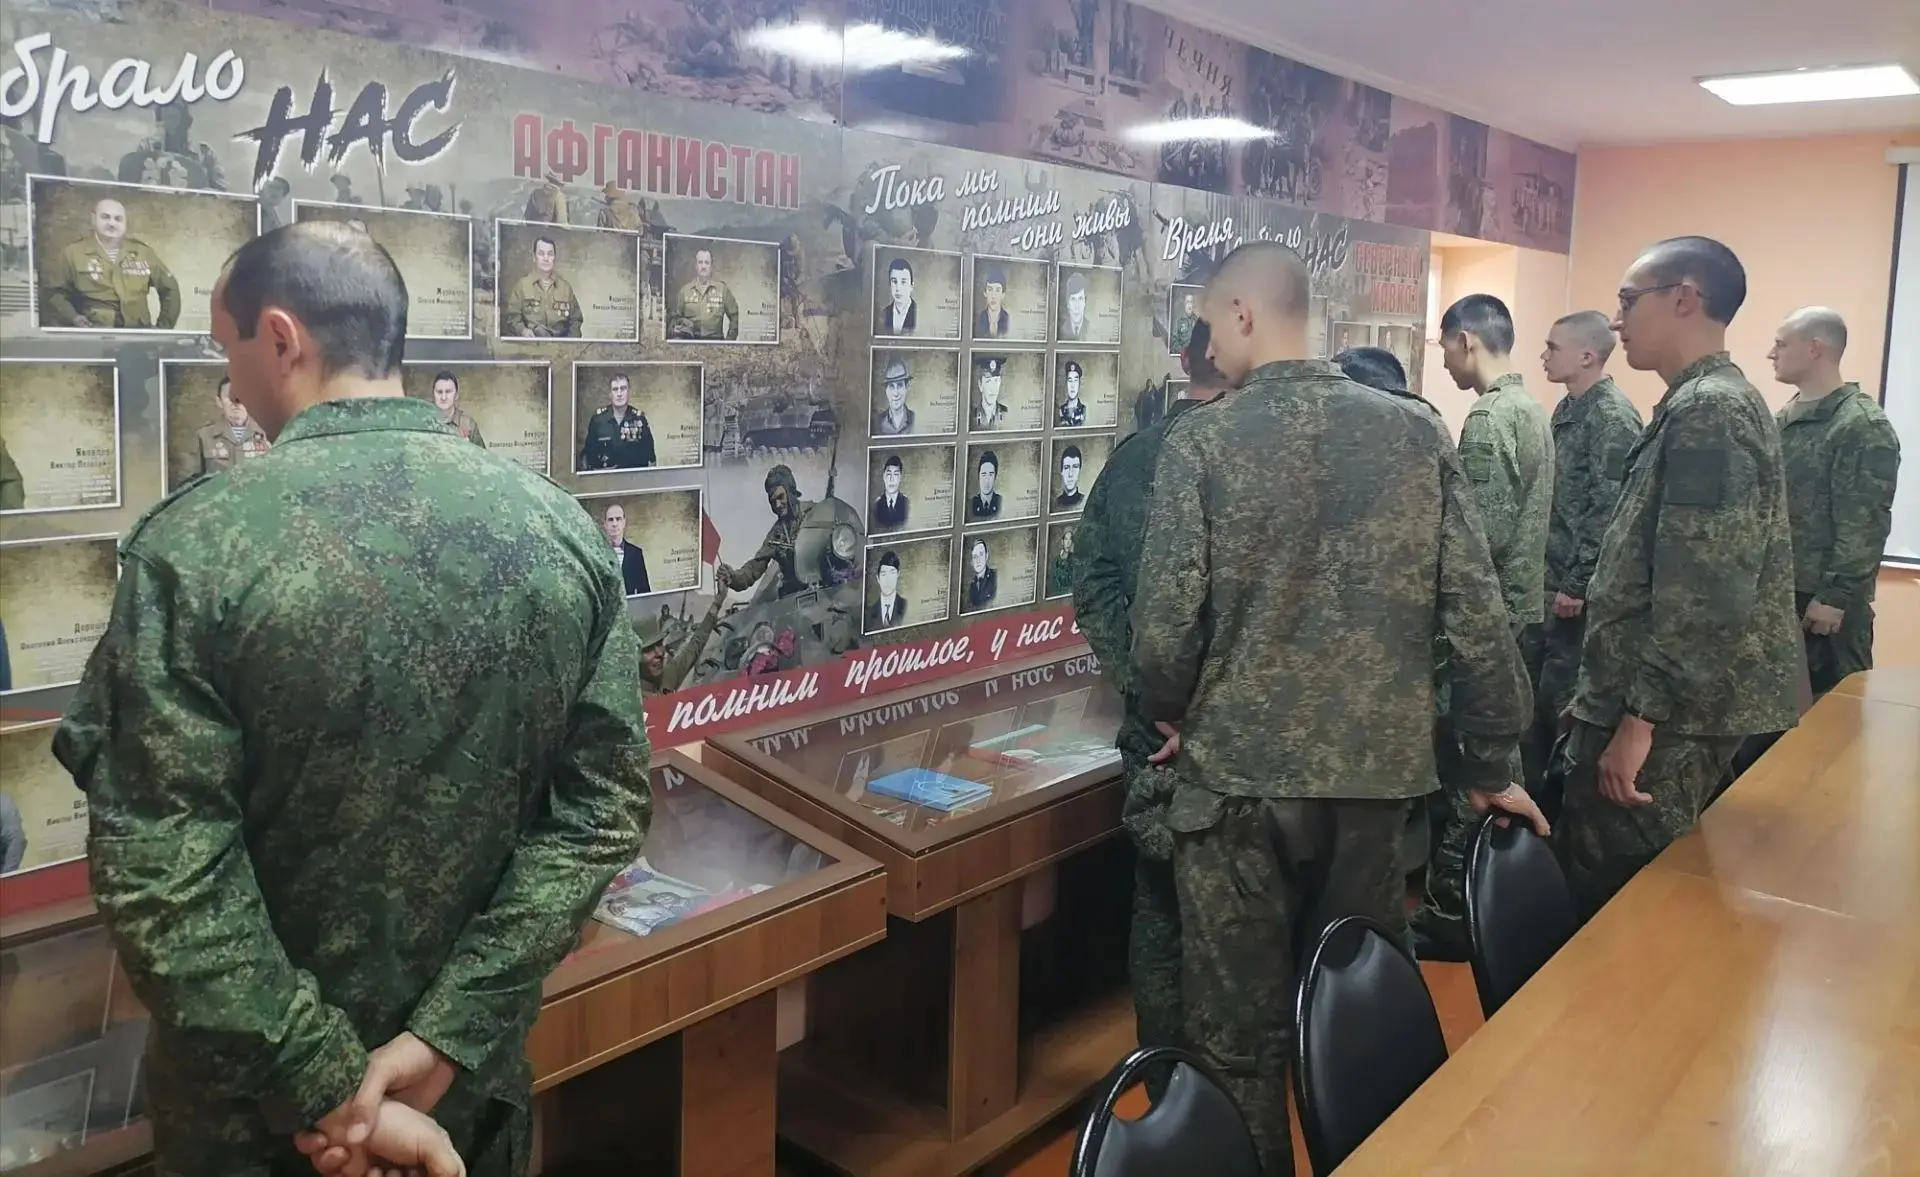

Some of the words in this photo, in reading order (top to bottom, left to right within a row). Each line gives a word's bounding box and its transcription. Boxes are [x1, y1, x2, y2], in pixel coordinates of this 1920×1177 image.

[1163, 25, 1233, 95] ЧЕЧНЯ
[231, 67, 464, 193] НАС
[512, 110, 800, 210] АФГАНИСТАН
[865, 164, 946, 214] Пока
[955, 168, 1000, 198] мы
[961, 190, 1061, 232] помним
[1072, 198, 1132, 241] живы
[1162, 216, 1234, 268] Время
[667, 672, 819, 734] помним
[845, 635, 974, 693] прошлое,
[990, 628, 1008, 660] у
[1016, 616, 1064, 647] нас
